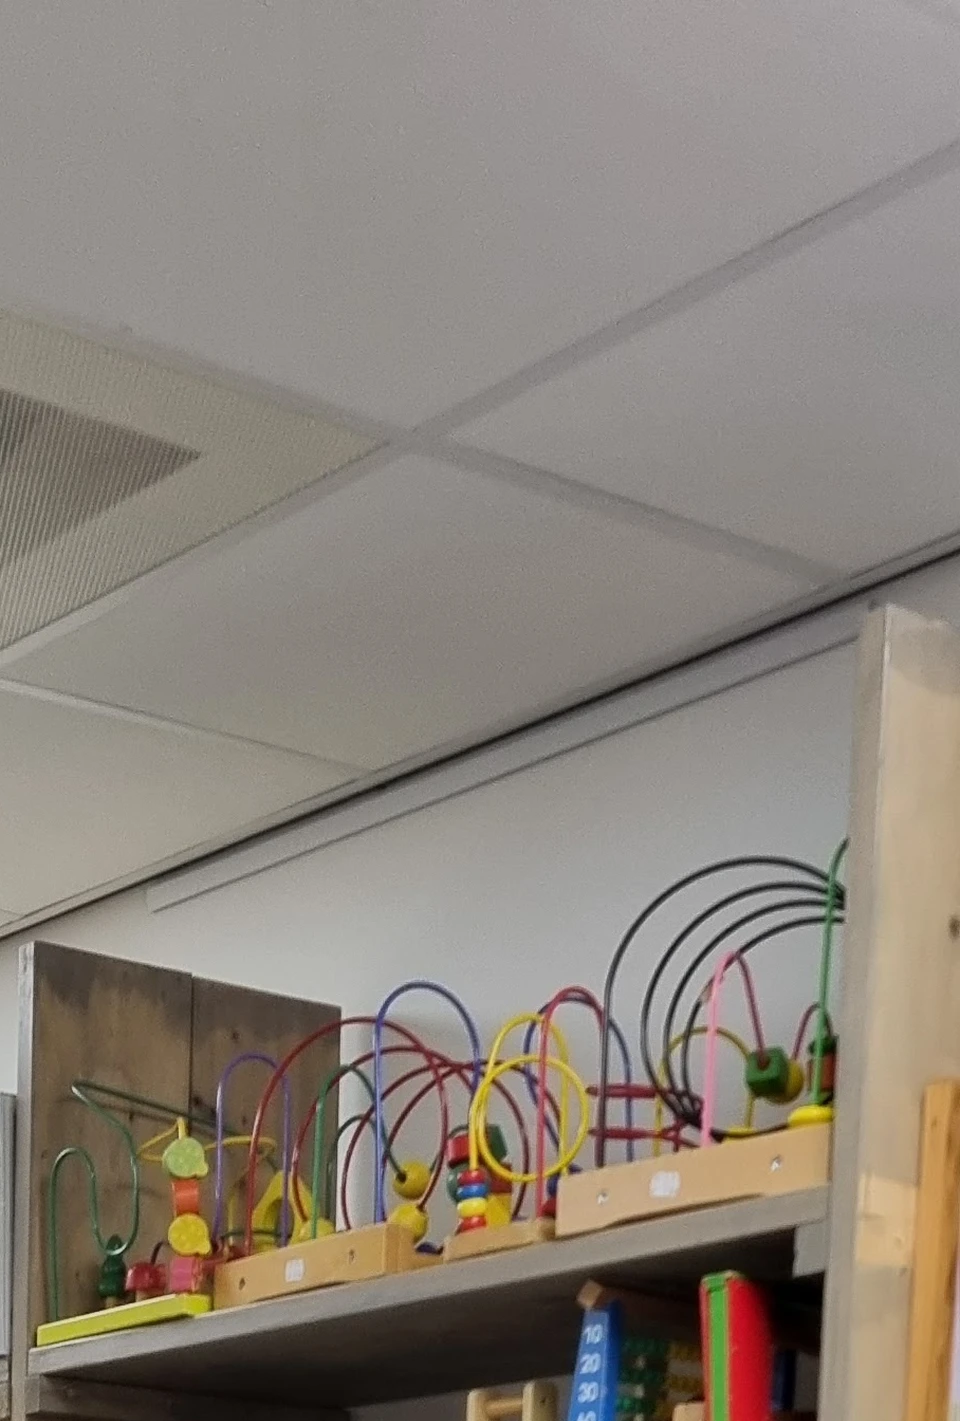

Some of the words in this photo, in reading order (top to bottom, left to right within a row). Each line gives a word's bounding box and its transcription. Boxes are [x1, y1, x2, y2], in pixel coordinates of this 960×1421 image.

[583, 1324, 603, 1344] 10
[580, 1353, 601, 1374] 20
[578, 1381, 599, 1403] 30
